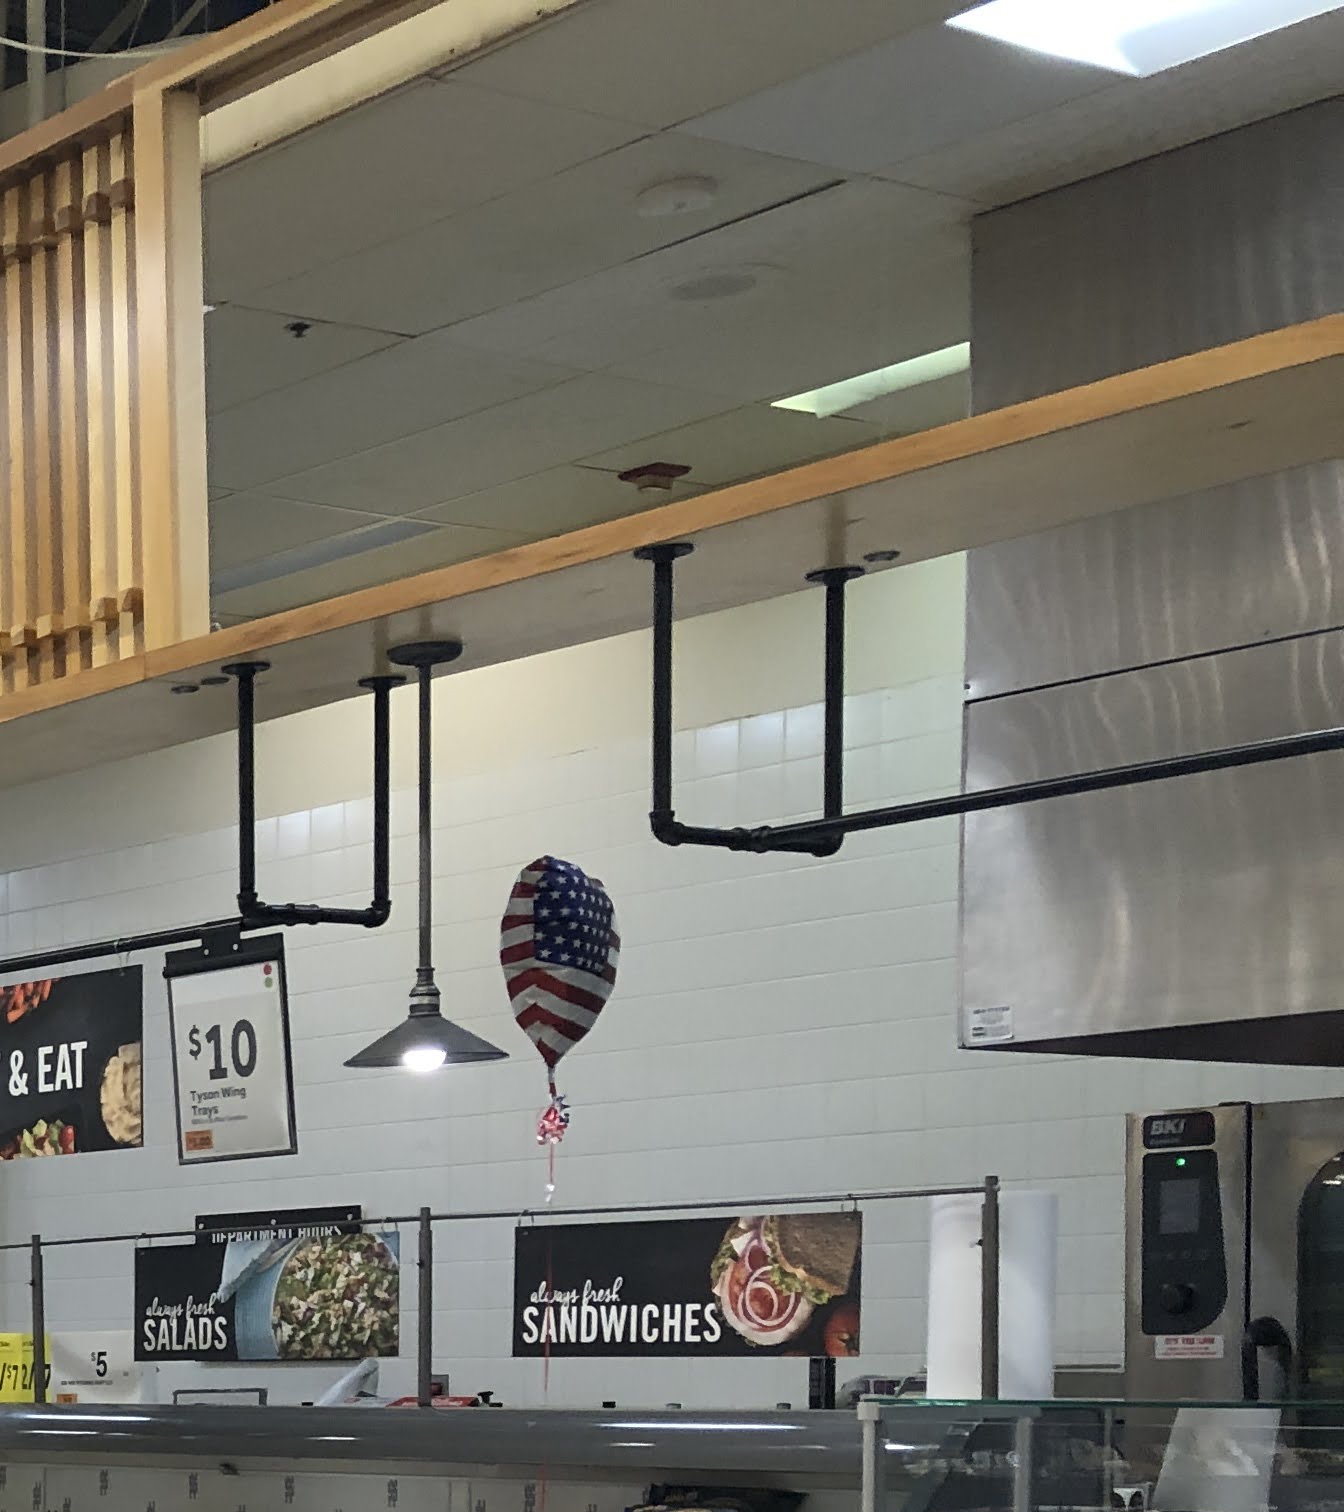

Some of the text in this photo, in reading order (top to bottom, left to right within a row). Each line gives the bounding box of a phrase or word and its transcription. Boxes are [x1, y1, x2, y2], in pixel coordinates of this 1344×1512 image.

[188, 1018, 257, 1081] $10
[8, 1049, 29, 1097] &
[38, 1041, 88, 1093] EAT
[189, 1086, 246, 1104] Tyson Wing
[191, 1104, 219, 1117] Trays
[146, 1291, 217, 1325] always fresh
[530, 1276, 624, 1308] always fresh
[143, 1316, 228, 1352] SALADS
[522, 1302, 722, 1344] SANDWICHES
[90, 1351, 108, 1377] $5
